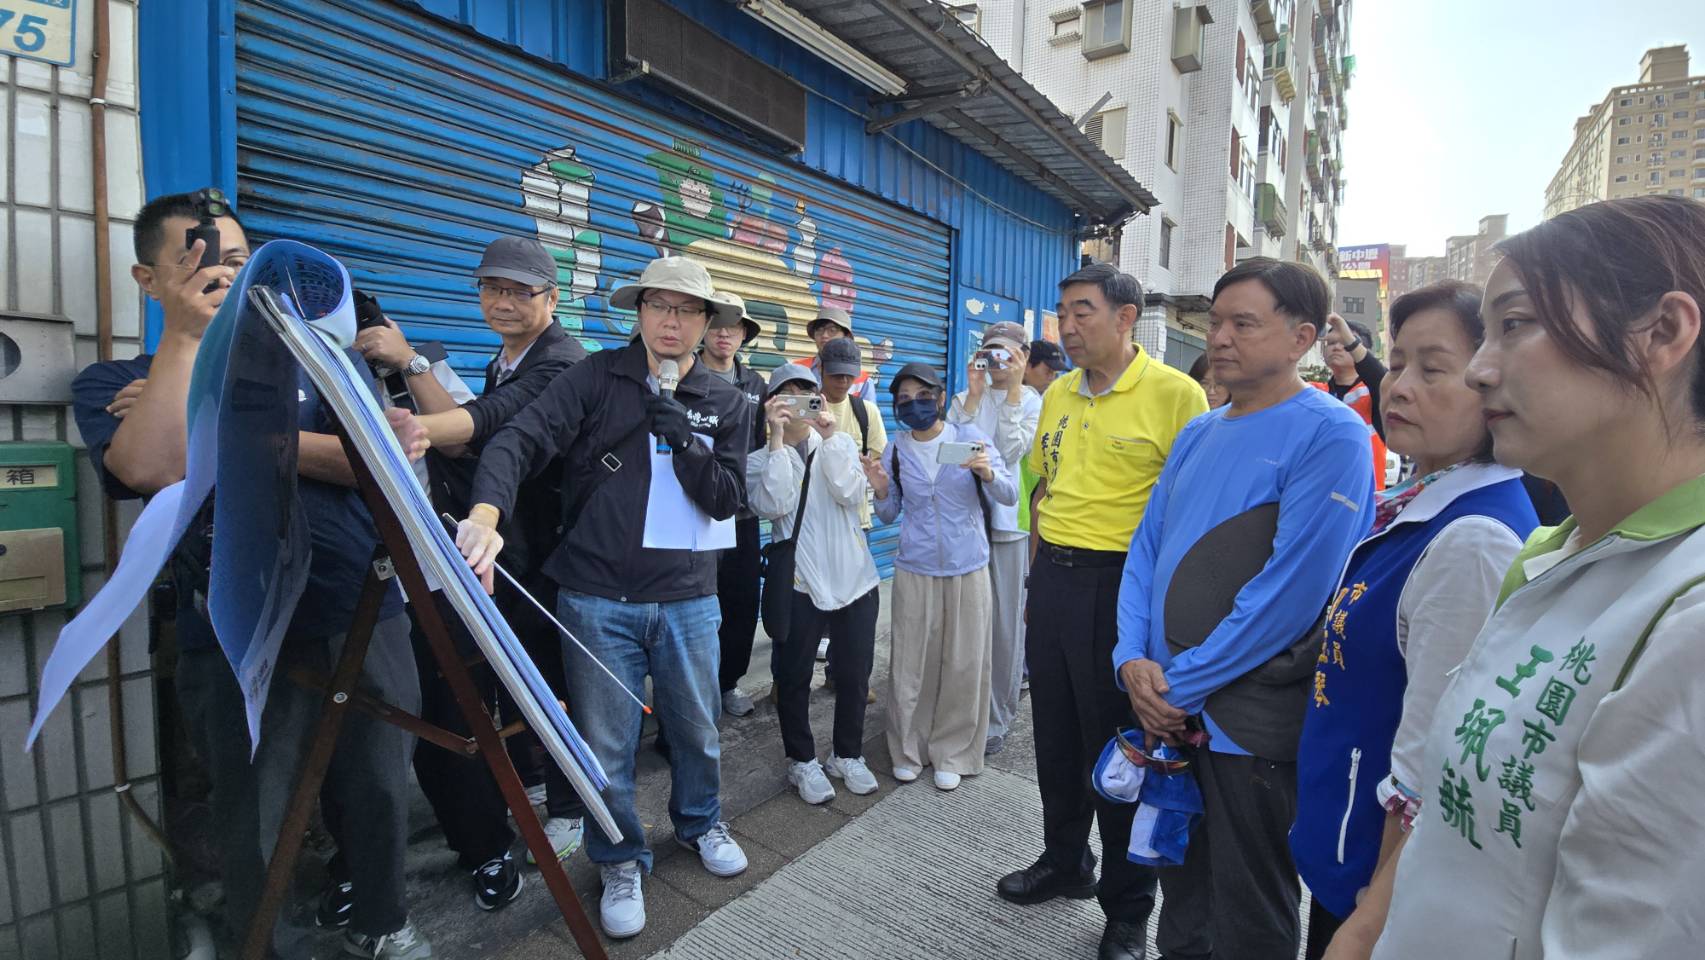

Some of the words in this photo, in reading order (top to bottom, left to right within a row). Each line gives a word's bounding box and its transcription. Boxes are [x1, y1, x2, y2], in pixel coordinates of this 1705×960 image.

[6, 469, 35, 486] 箱
[1332, 581, 1368, 670] 市議員
[1438, 644, 1555, 851] 王珮毓
[1495, 635, 1597, 849] 桃園市議員
